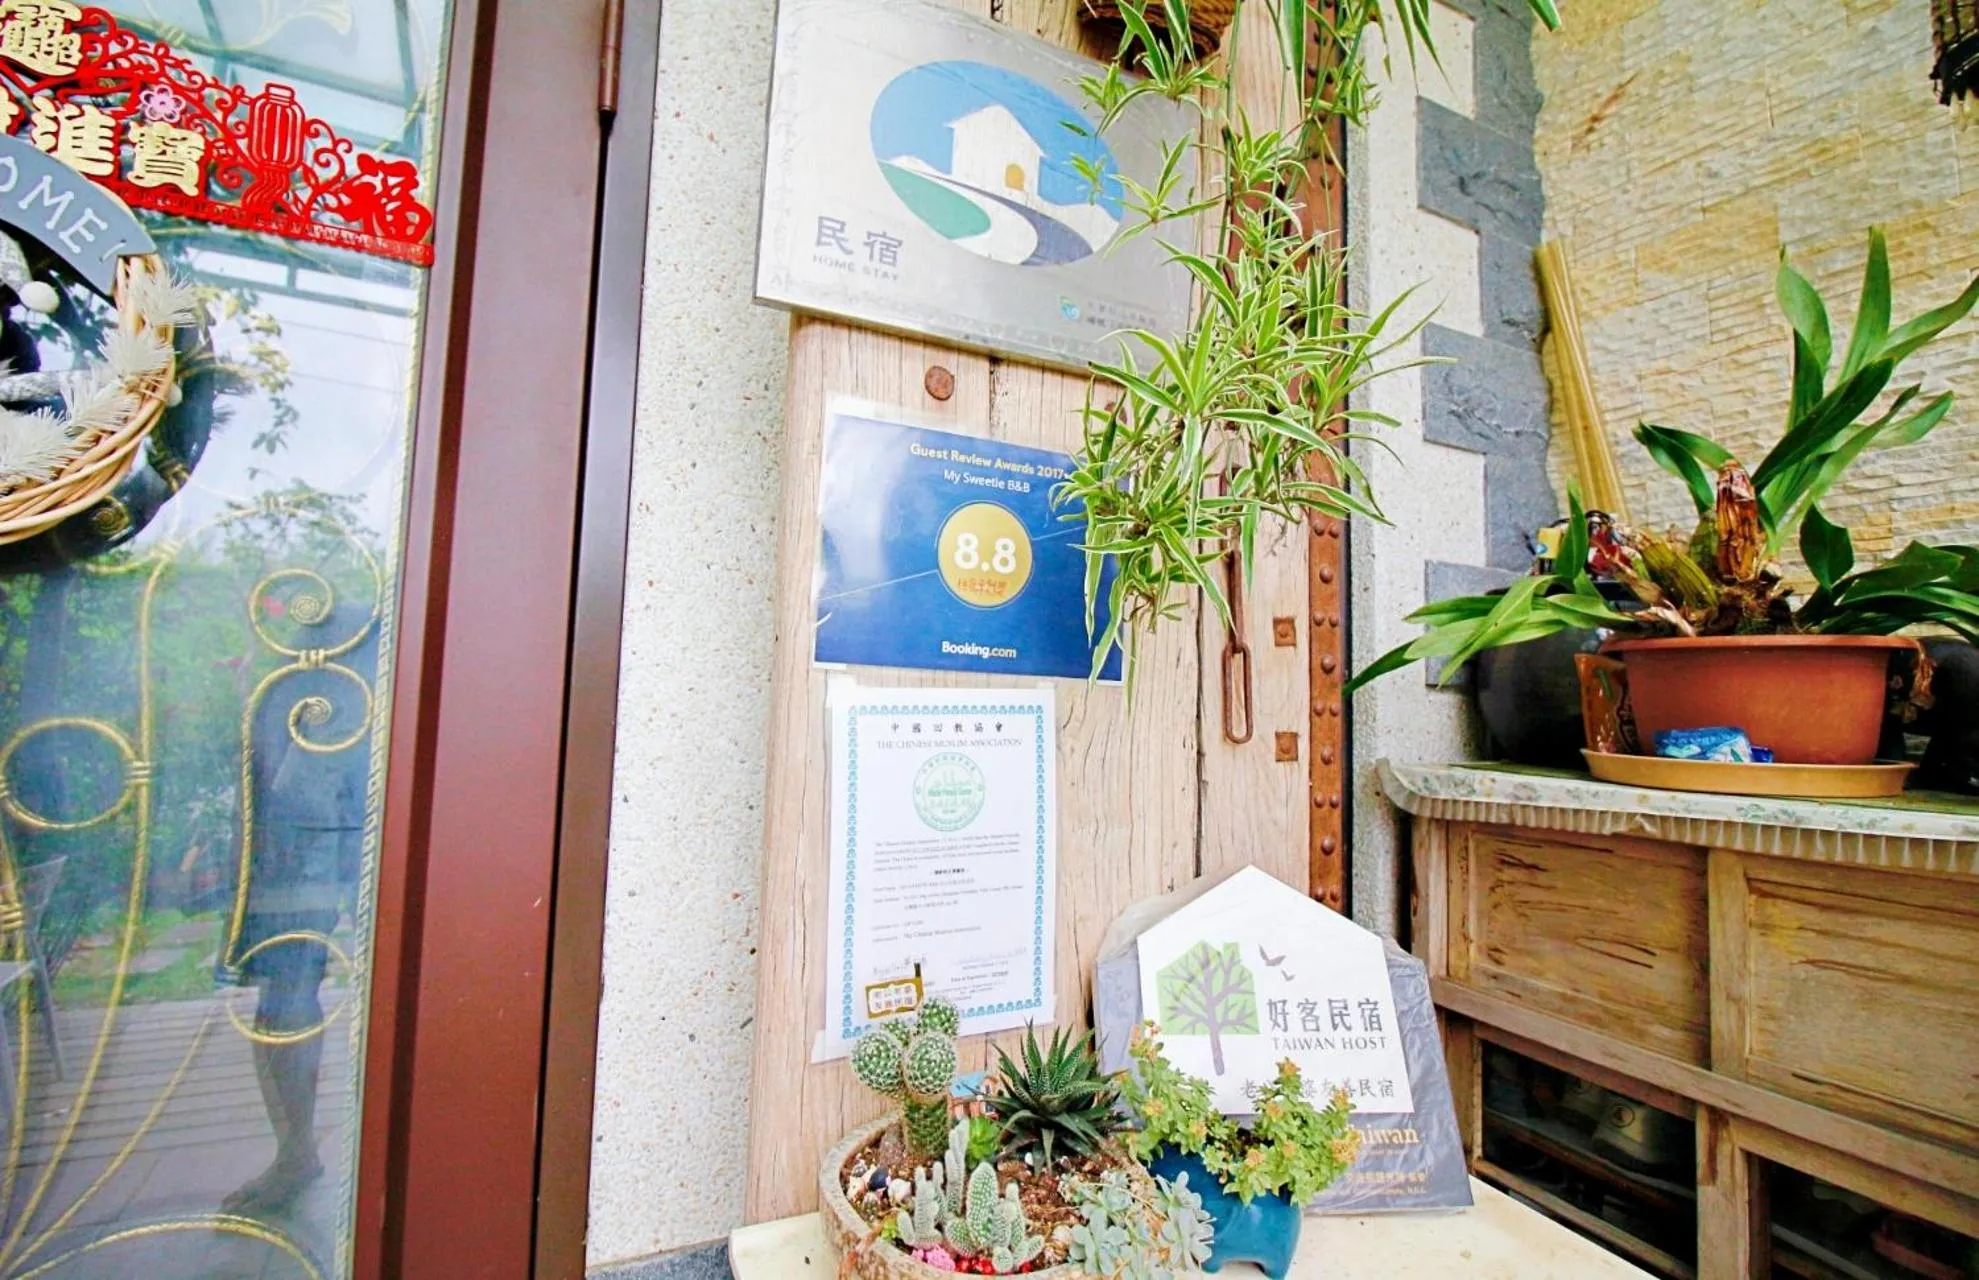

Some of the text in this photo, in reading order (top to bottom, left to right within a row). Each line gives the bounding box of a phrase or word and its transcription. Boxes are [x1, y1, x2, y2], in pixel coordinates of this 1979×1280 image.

[0, 86, 205, 196] 進寶
[815, 215, 904, 268] 民宿
[812, 254, 855, 273] HOME
[910, 442, 1065, 480] Guest Review Awards 2017
[944, 469, 1031, 493] My Sweetie B&B
[955, 532, 1017, 575] 8.8
[941, 640, 1017, 659] Booking.com
[1267, 997, 1383, 1033] 好客民宿
[1271, 1036, 1387, 1051] TAIWAN HOST
